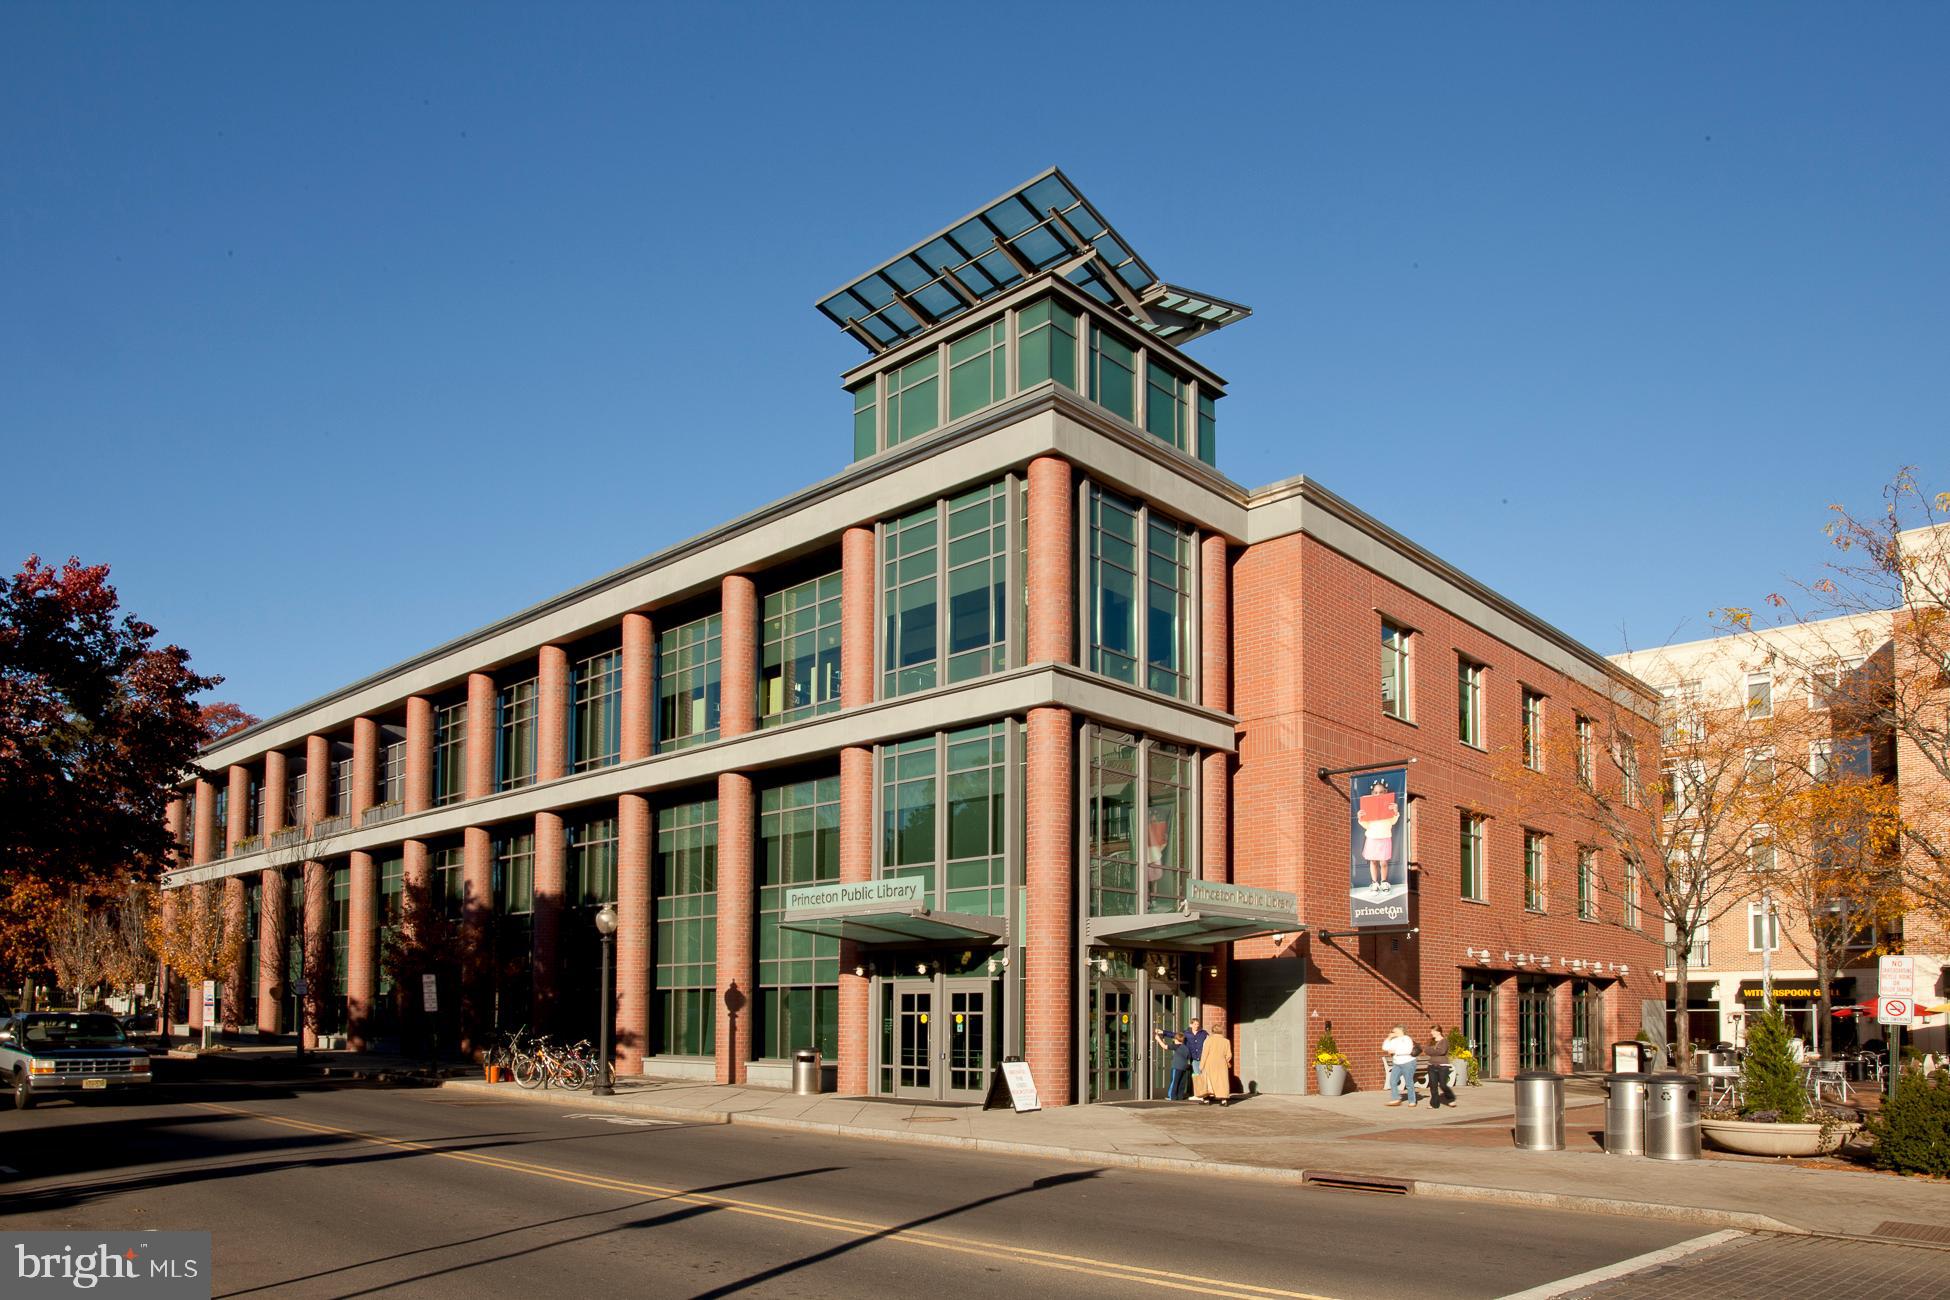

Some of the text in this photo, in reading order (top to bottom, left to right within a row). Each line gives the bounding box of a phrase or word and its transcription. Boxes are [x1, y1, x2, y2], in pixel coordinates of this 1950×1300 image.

[791, 883, 917, 906] Princeton Public Library
[1191, 884, 1295, 913] Princeton Public Library
[1354, 905, 1403, 920] princeton
